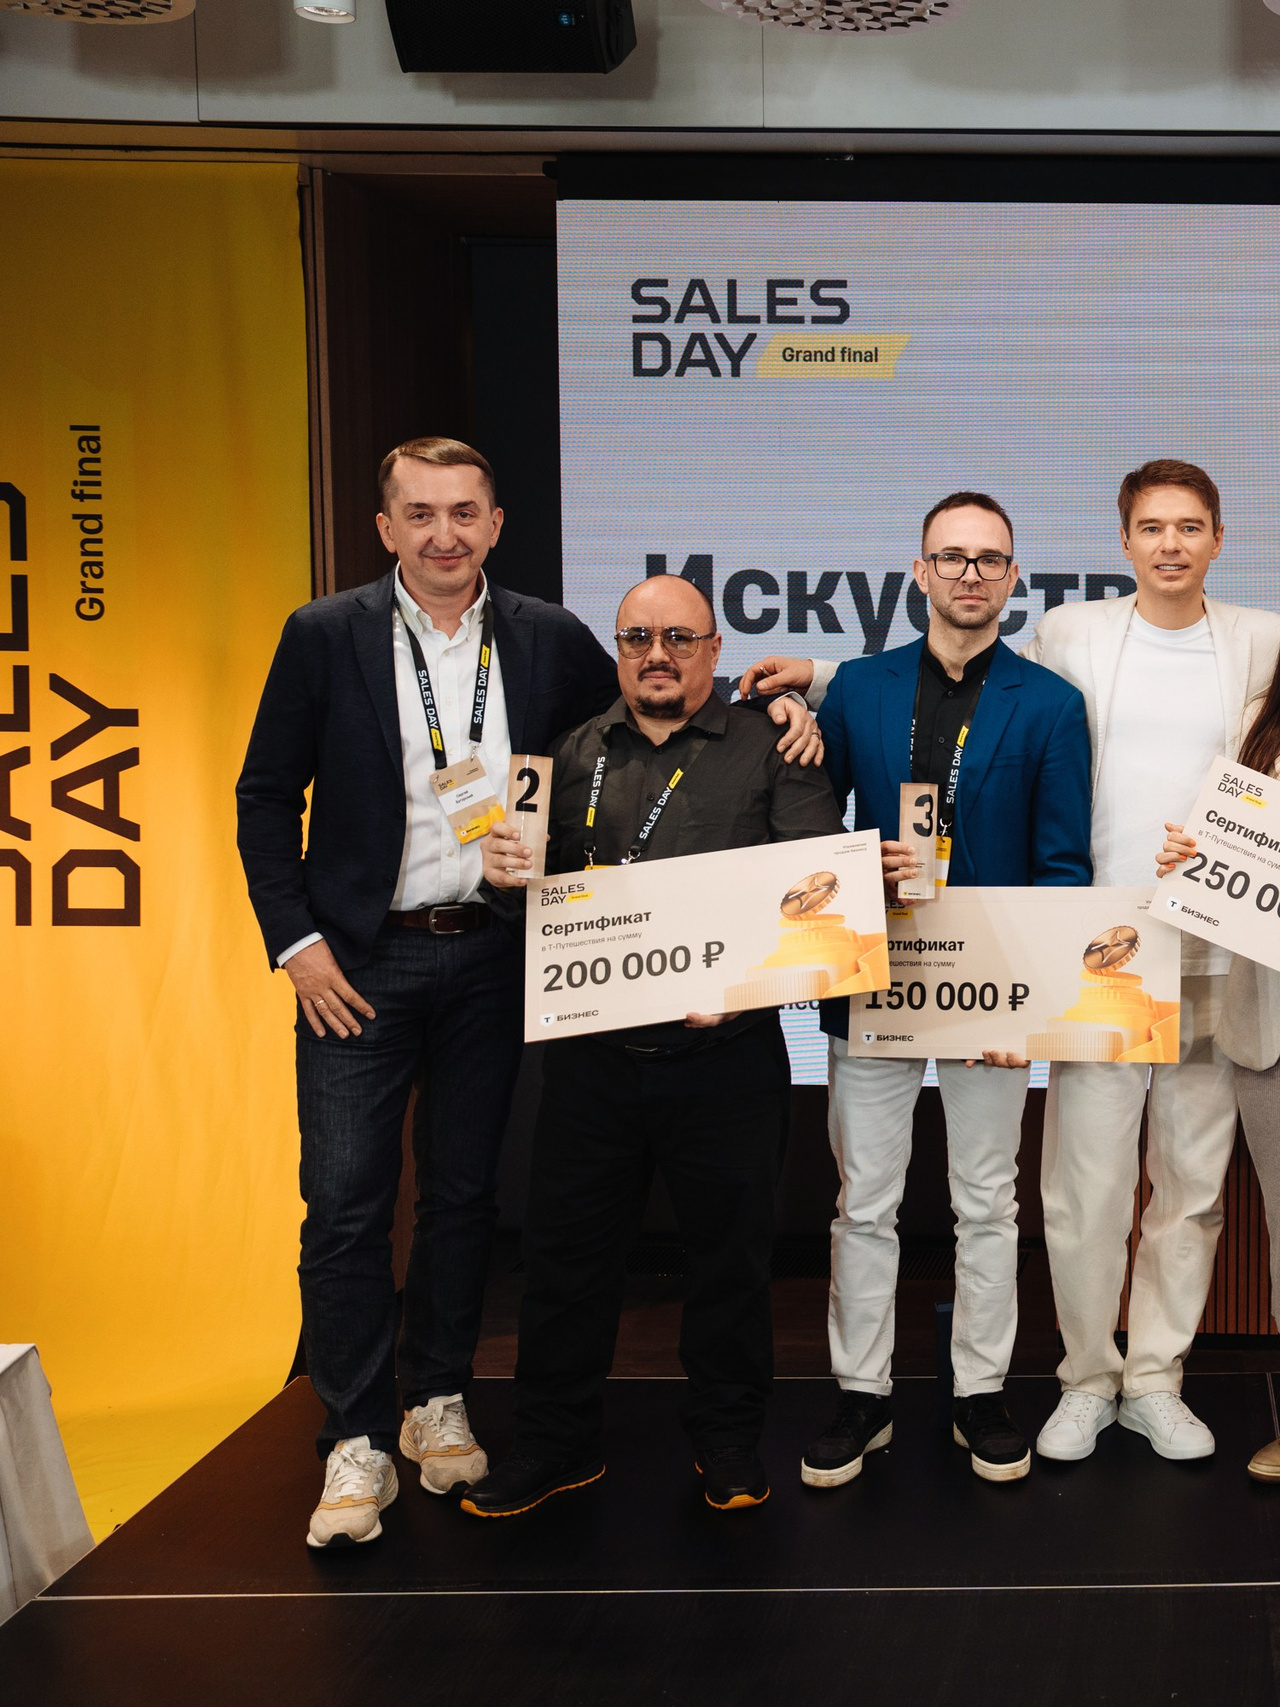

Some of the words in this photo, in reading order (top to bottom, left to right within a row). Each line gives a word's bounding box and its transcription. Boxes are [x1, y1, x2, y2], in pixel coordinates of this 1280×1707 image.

[631, 278, 850, 324] SALES
[632, 332, 757, 377] DAY
[782, 347, 835, 362] Grand
[840, 347, 879, 362] final
[69, 425, 103, 505] final
[72, 512, 105, 622] Grand
[478, 666, 488, 688] DAY
[418, 669, 434, 705] SALES
[426, 706, 439, 729] DAY
[473, 689, 486, 724] SALES
[952, 745, 964, 766] DAY
[592, 756, 606, 788] SALES
[946, 769, 959, 804] SALES
[1222, 773, 1264, 797] SALES
[48, 672, 141, 926] DAY
[515, 767, 540, 813] 2
[589, 789, 600, 807] DAY
[1217, 782, 1243, 798] DAY
[639, 806, 661, 840] SALES
[657, 786, 673, 806] DAY
[913, 793, 934, 837] 3
[1204, 831, 1257, 860] Т-Путешествия
[1257, 855, 1267, 864] на
[541, 883, 586, 897] SALES
[1182, 851, 1251, 900] 250
[541, 895, 567, 907] DAY
[1181, 905, 1220, 927] БИЗНЕС
[541, 911, 652, 936] Сертификат
[548, 936, 606, 951] Т-Путешествия
[607, 934, 616, 942] на
[618, 931, 643, 943] сумму
[887, 938, 965, 954] ртификат
[543, 957, 612, 993] 200
[622, 945, 692, 980] 000
[702, 940, 725, 969] ₽
[933, 961, 956, 969] сумму
[865, 981, 927, 1010] 150
[936, 981, 999, 1011] 000
[1008, 983, 1030, 1012] ₽
[557, 1009, 600, 1022] БИЗНЕС
[876, 1034, 914, 1042] БИЗНЕС
